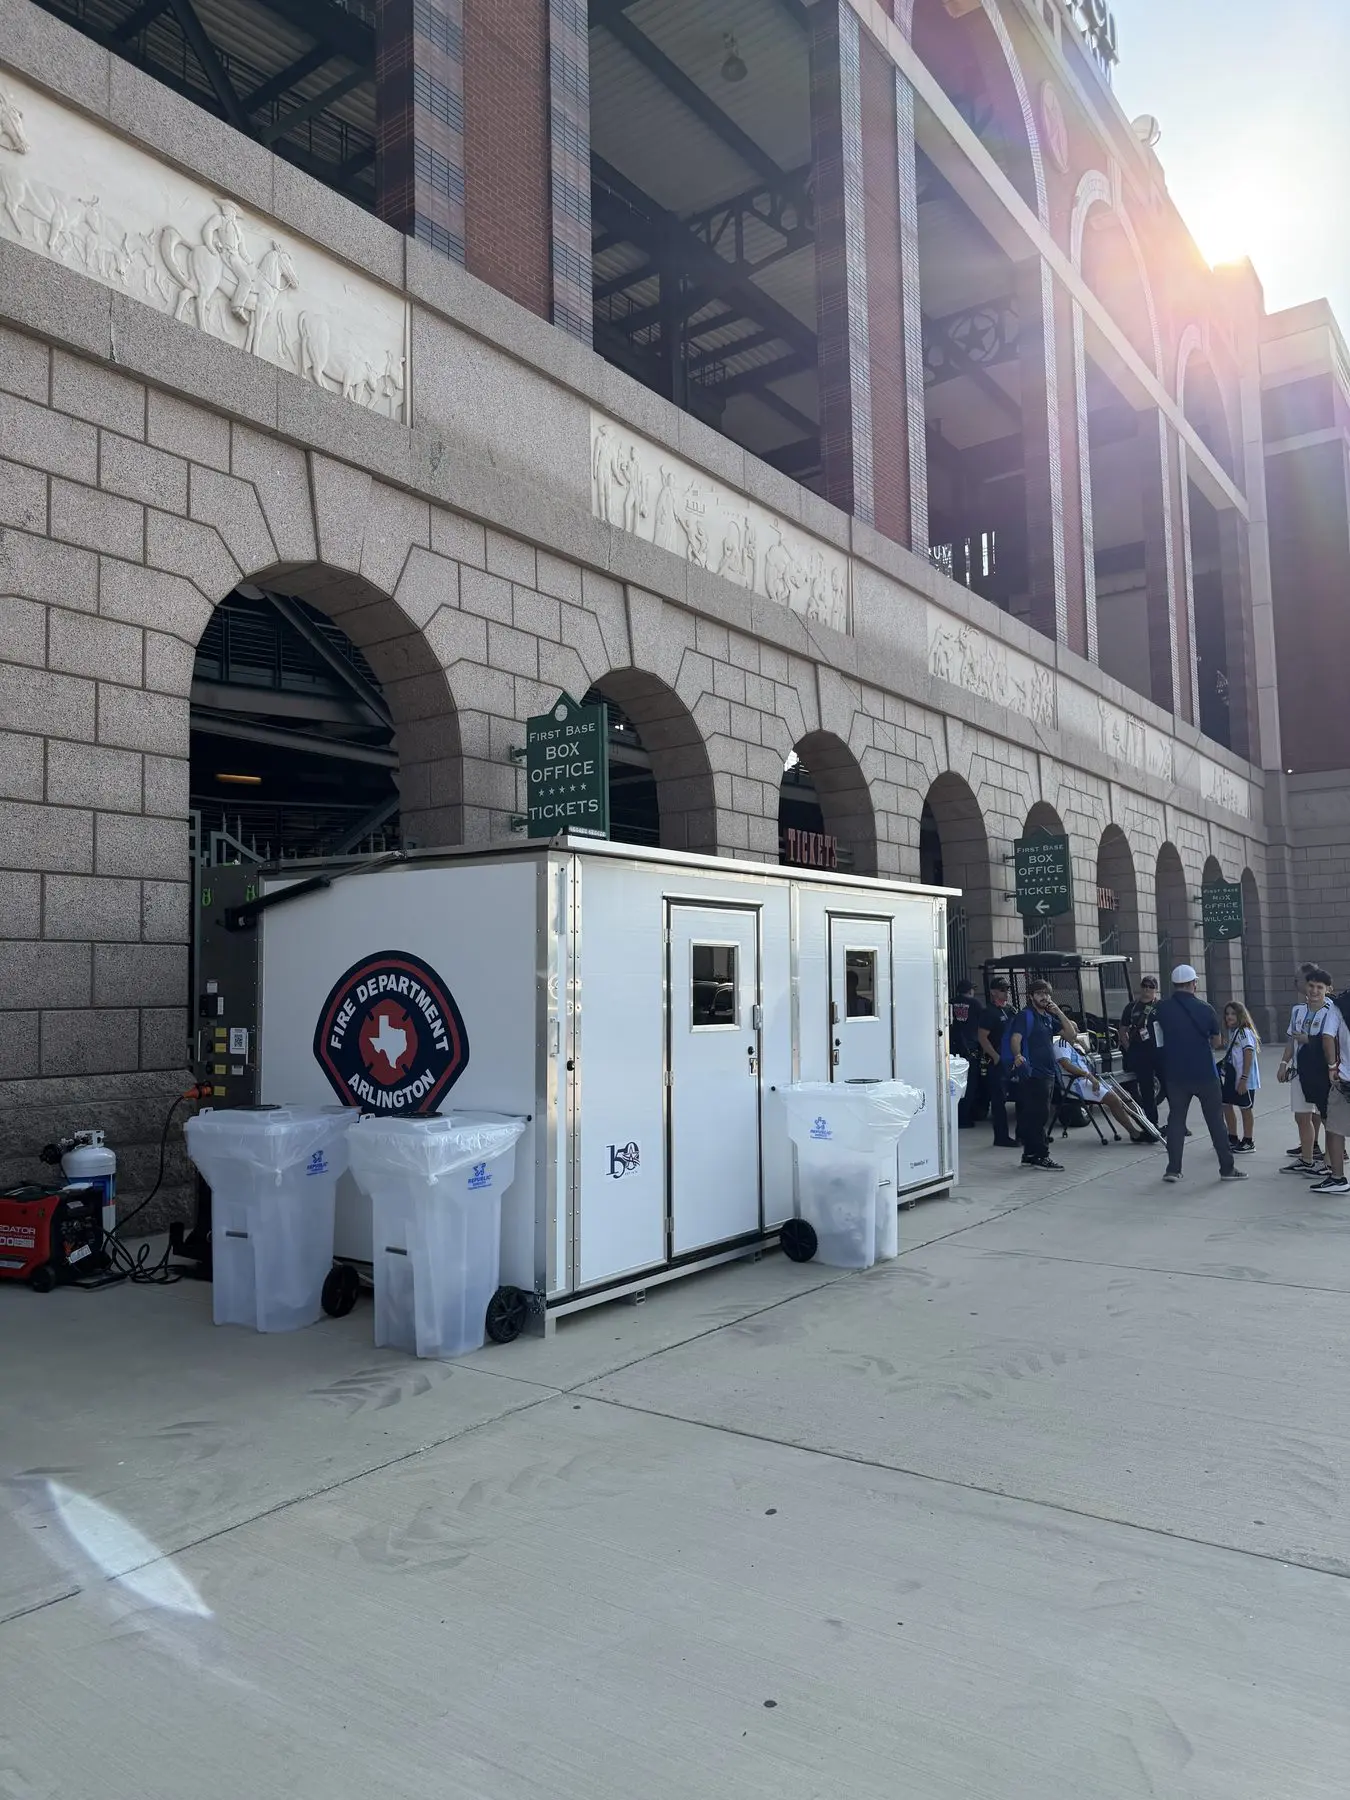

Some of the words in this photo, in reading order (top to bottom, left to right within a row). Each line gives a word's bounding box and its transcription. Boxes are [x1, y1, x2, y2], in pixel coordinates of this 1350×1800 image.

[529, 729, 561, 743] FIRST
[566, 723, 596, 736] BASE
[545, 742, 580, 760] BOX
[531, 760, 594, 783] OFFICE
[529, 799, 599, 820] TICKETS
[788, 827, 838, 868] TICKETS
[1028, 854, 1053, 864] BOX
[1018, 864, 1064, 876] OFFICE
[1017, 885, 1067, 896] TICKETS
[330, 998, 357, 1050] FIRE
[356, 974, 449, 1051] DEPARTMENT
[347, 1068, 436, 1109] ARLINGTON
